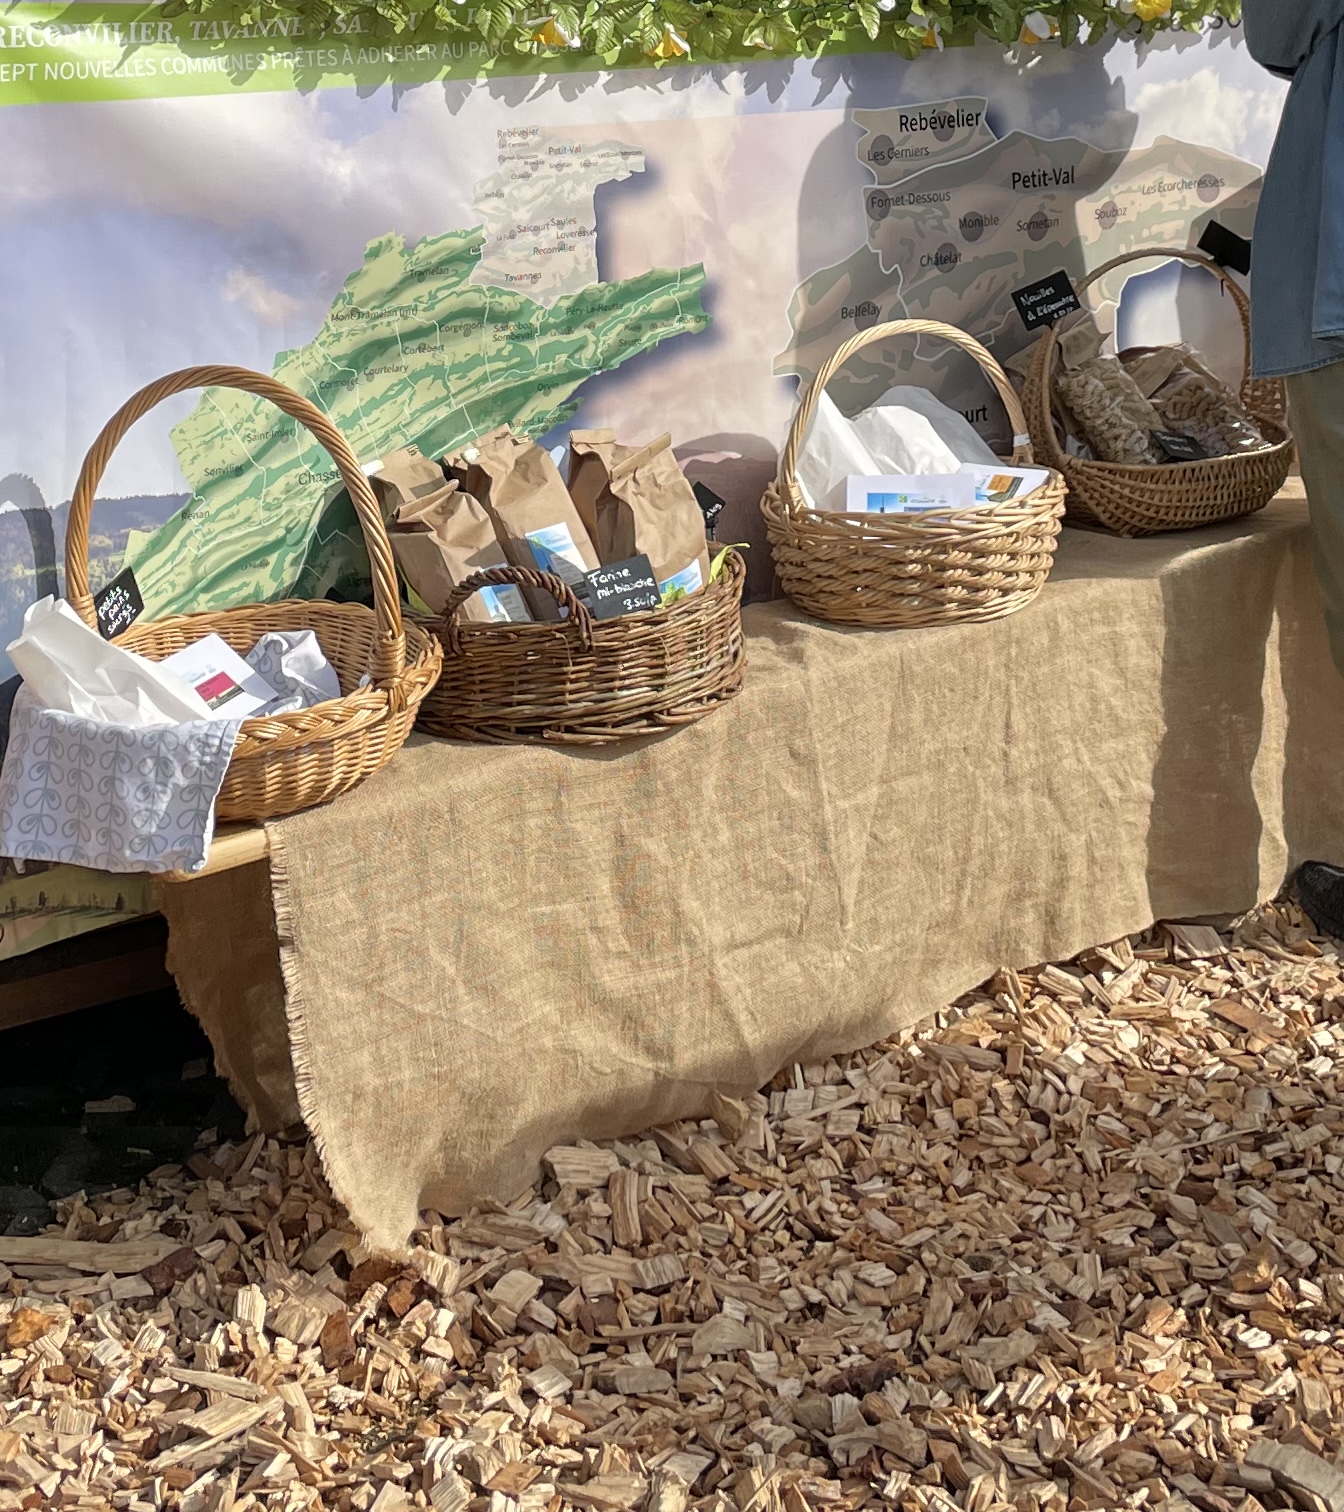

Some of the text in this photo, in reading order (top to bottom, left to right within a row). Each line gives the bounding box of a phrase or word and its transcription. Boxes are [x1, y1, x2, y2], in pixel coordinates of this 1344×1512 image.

[187, 17, 326, 42] TAVANNE,
[44, 57, 157, 81] NOUVELLES
[160, 51, 267, 76] COMMUNES
[271, 47, 338, 71] PRÊTES
[342, 43, 354, 66] À
[357, 41, 438, 66] ADHÉRER
[441, 42, 464, 60] AU
[468, 40, 511, 59] PARC
[898, 109, 982, 134] Rebévelier
[497, 127, 540, 139] Rebévelier
[548, 144, 583, 156] Petit-Val
[867, 145, 930, 161] Les Cerniers
[1011, 164, 1076, 190] Petit-Val
[1142, 180, 1157, 196] Les
[1094, 204, 1128, 222] Souboz
[958, 213, 1000, 230] Monible
[1016, 215, 1060, 232] Sometan
[556, 229, 596, 240] Loveresse
[919, 250, 963, 268] Châtelat
[409, 266, 449, 279] Tramelan
[331, 308, 398, 322] Mont-Tramelan
[403, 343, 445, 356] Cortébert
[363, 364, 409, 378] Courtelary
[247, 427, 295, 443] Saint-Imier
[204, 464, 245, 476] Sonvilier
[181, 510, 210, 521] Renan
[587, 568, 632, 588] Farine
[98, 586, 122, 621] petits
